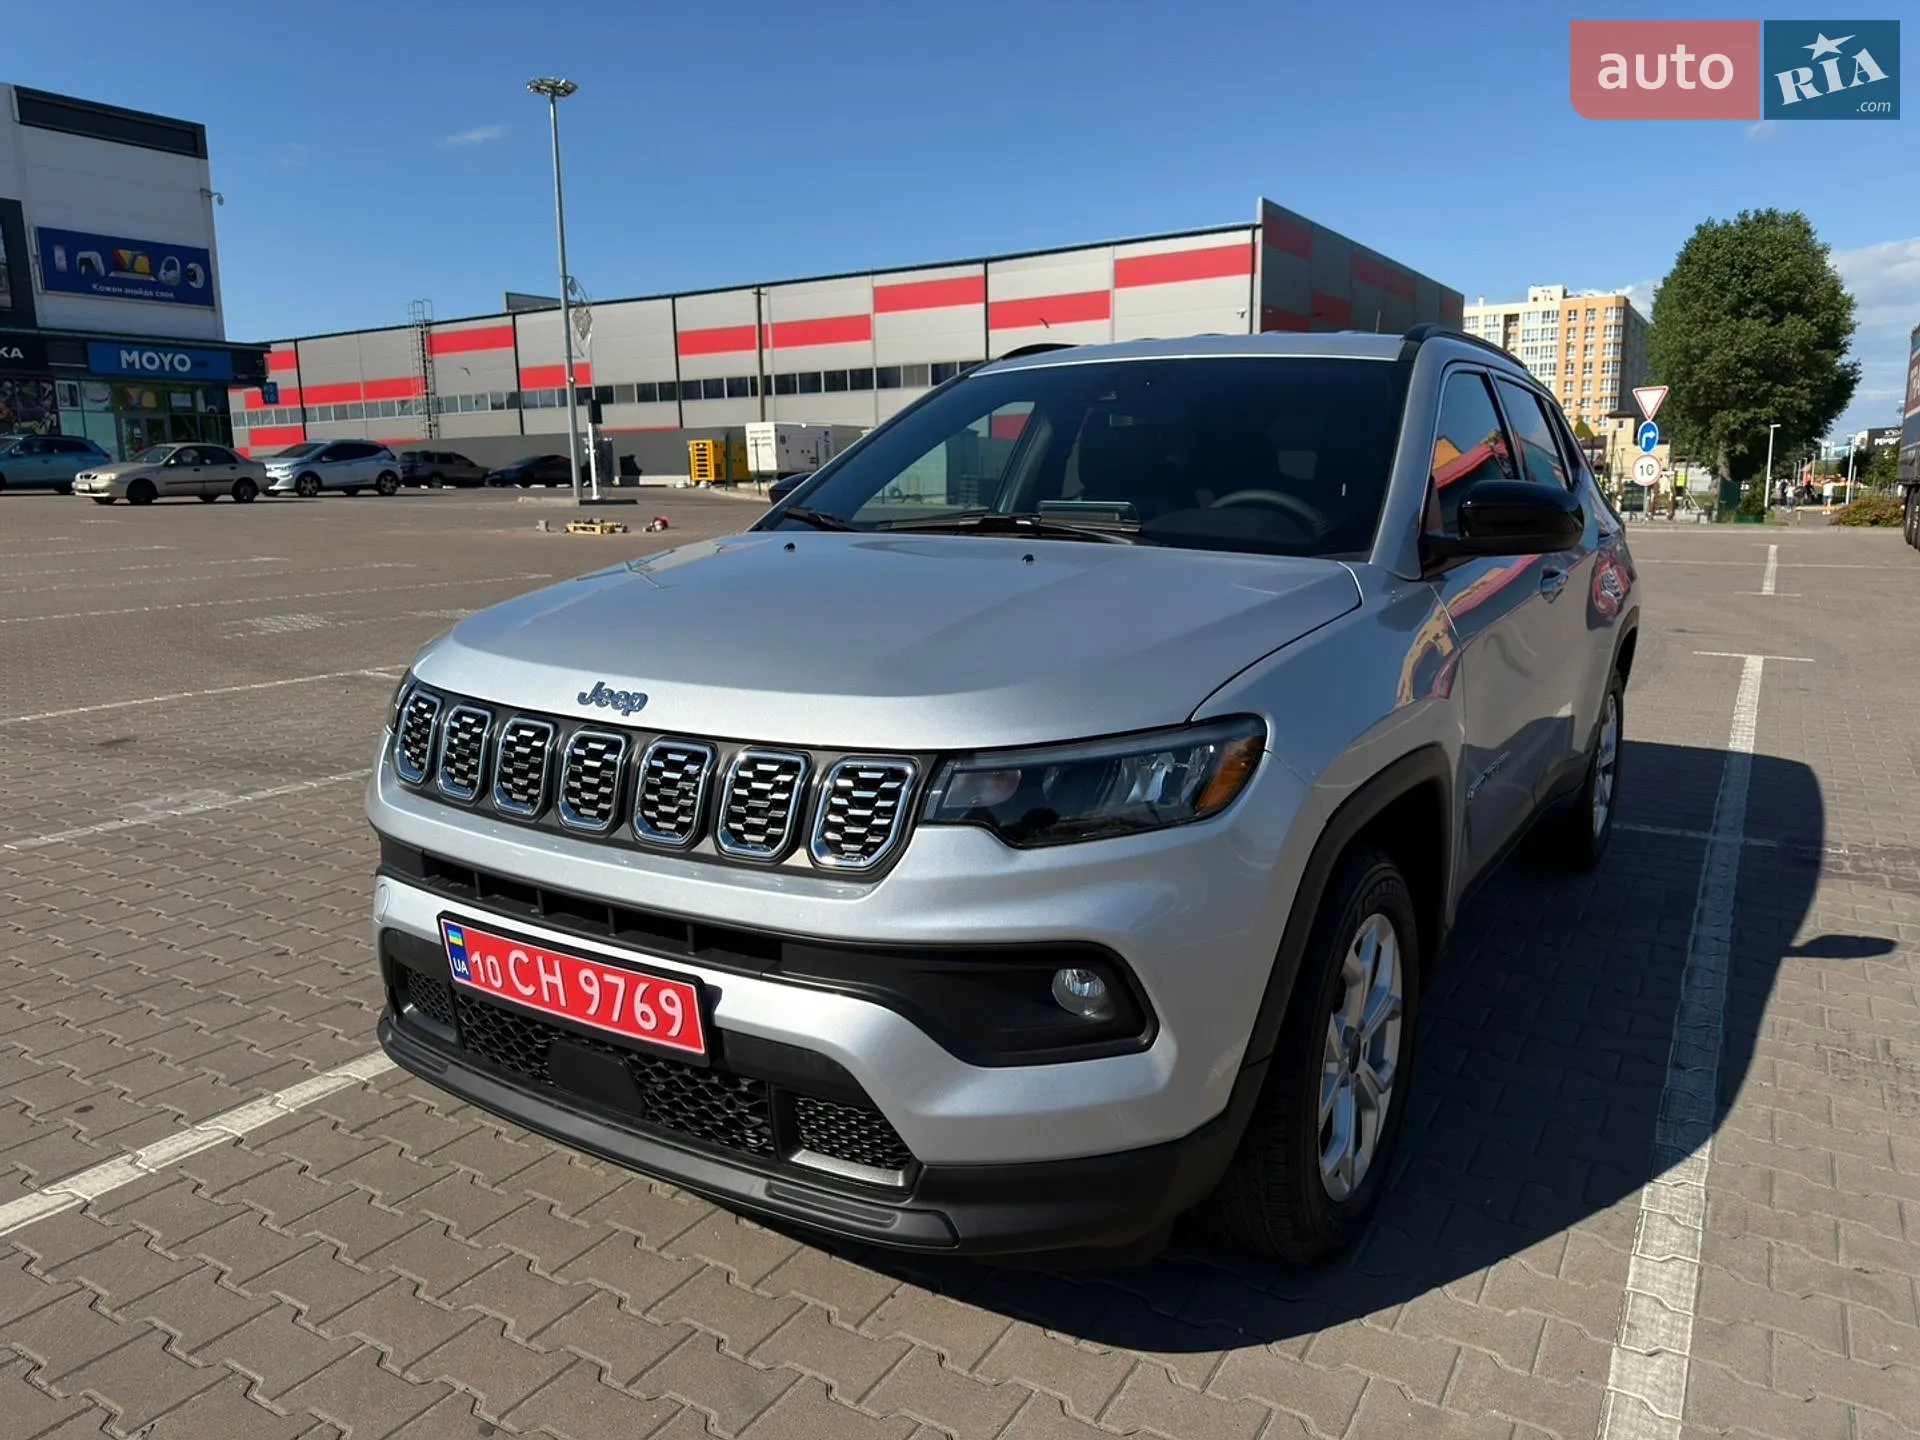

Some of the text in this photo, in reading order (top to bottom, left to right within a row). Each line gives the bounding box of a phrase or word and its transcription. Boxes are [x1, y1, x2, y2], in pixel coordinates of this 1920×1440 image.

[92, 282, 123, 293] Кожен
[125, 286, 154, 297] знайде
[119, 349, 192, 373] MOYO
[1639, 463, 1655, 477] 10
[577, 681, 649, 717] Jeep
[452, 956, 470, 975] UA
[471, 949, 684, 1037] 10 CH 9769
